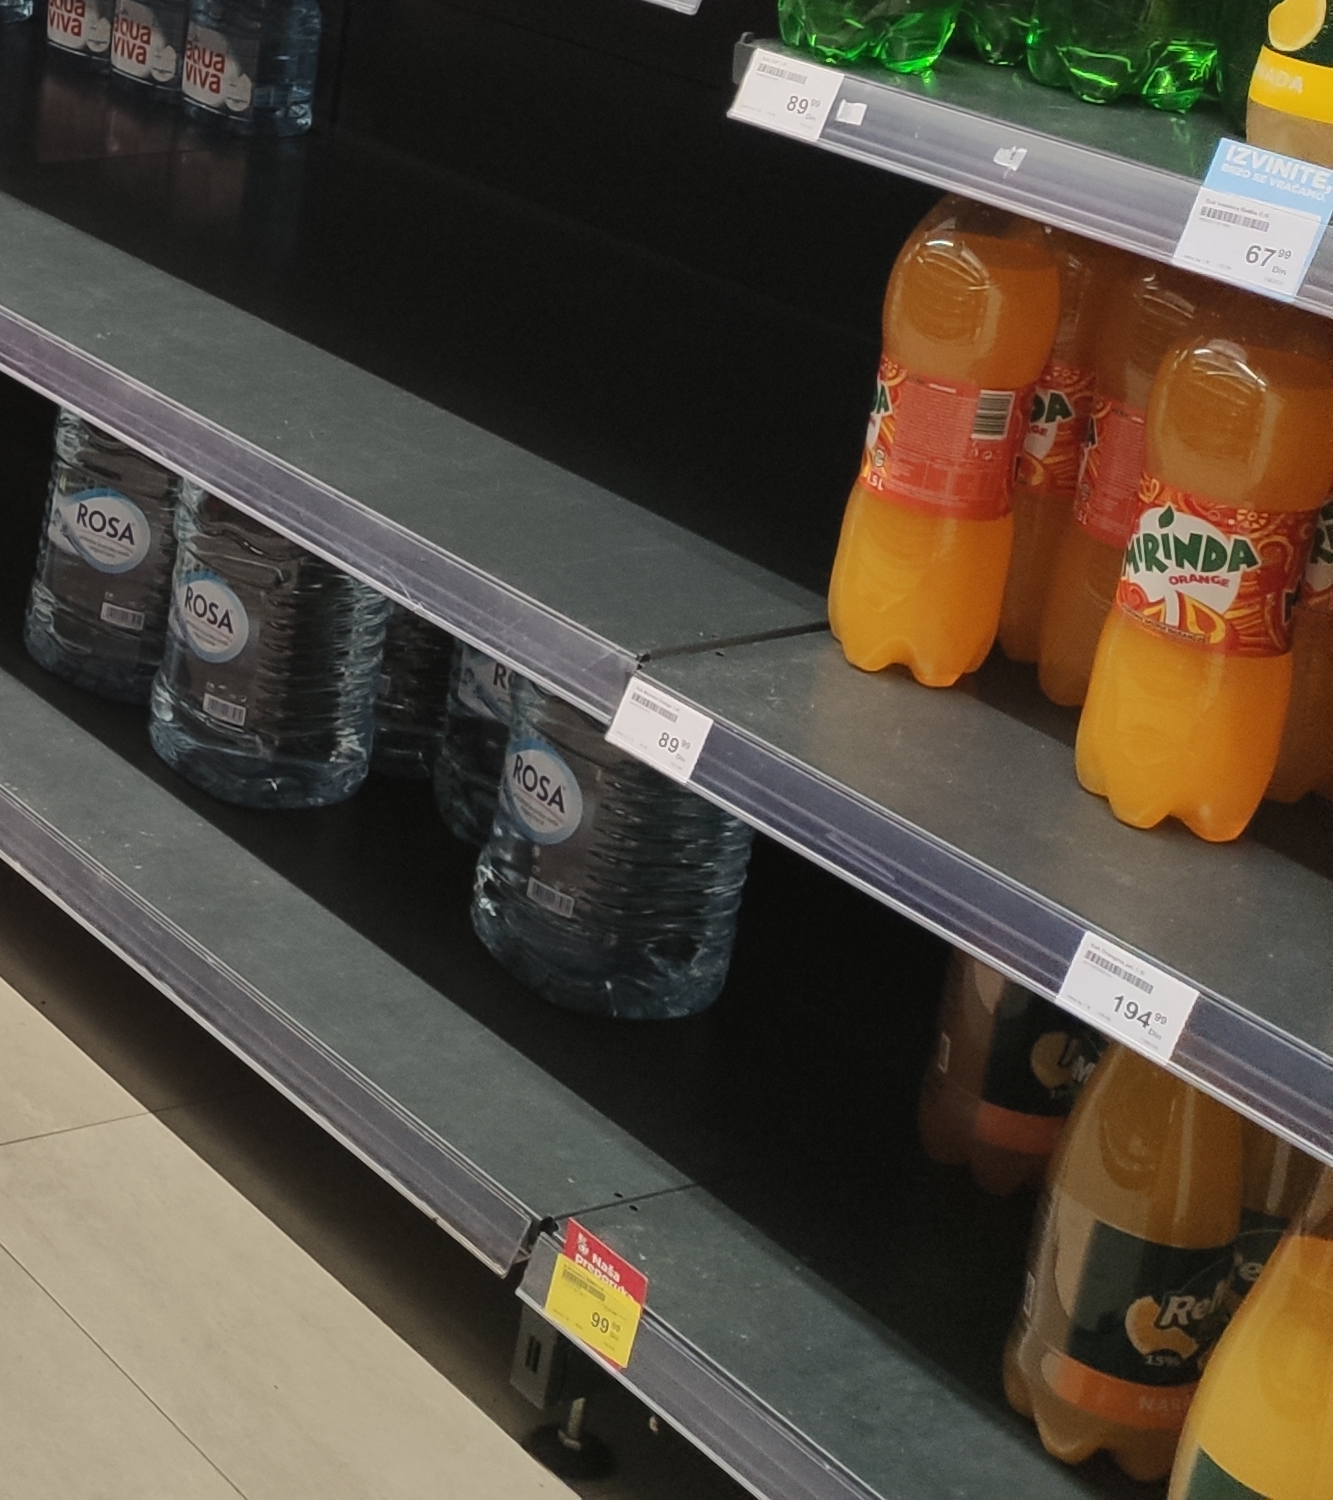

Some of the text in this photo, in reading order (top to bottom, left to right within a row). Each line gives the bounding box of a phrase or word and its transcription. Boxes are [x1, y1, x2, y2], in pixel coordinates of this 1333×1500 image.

[48, 8, 83, 38] viva
[113, 13, 151, 46] aqua
[112, 36, 147, 66] viva
[185, 40, 226, 75] aqua
[184, 63, 221, 95] viva
[786, 95, 809, 115] 89
[1225, 145, 1332, 195] IZVINITE,
[1252, 173, 1269, 184] SE
[1245, 244, 1292, 267] 67 99
[76, 501, 136, 548] ROSA
[1126, 532, 1260, 575] MIRINDA
[1168, 573, 1231, 588] ORANGE
[183, 584, 233, 636] ROSA
[658, 731, 680, 754] 89
[513, 755, 565, 816] ROSA
[1114, 995, 1167, 1029] 194 99
[592, 1252, 621, 1284] Naša
[590, 1310, 610, 1334] 99
